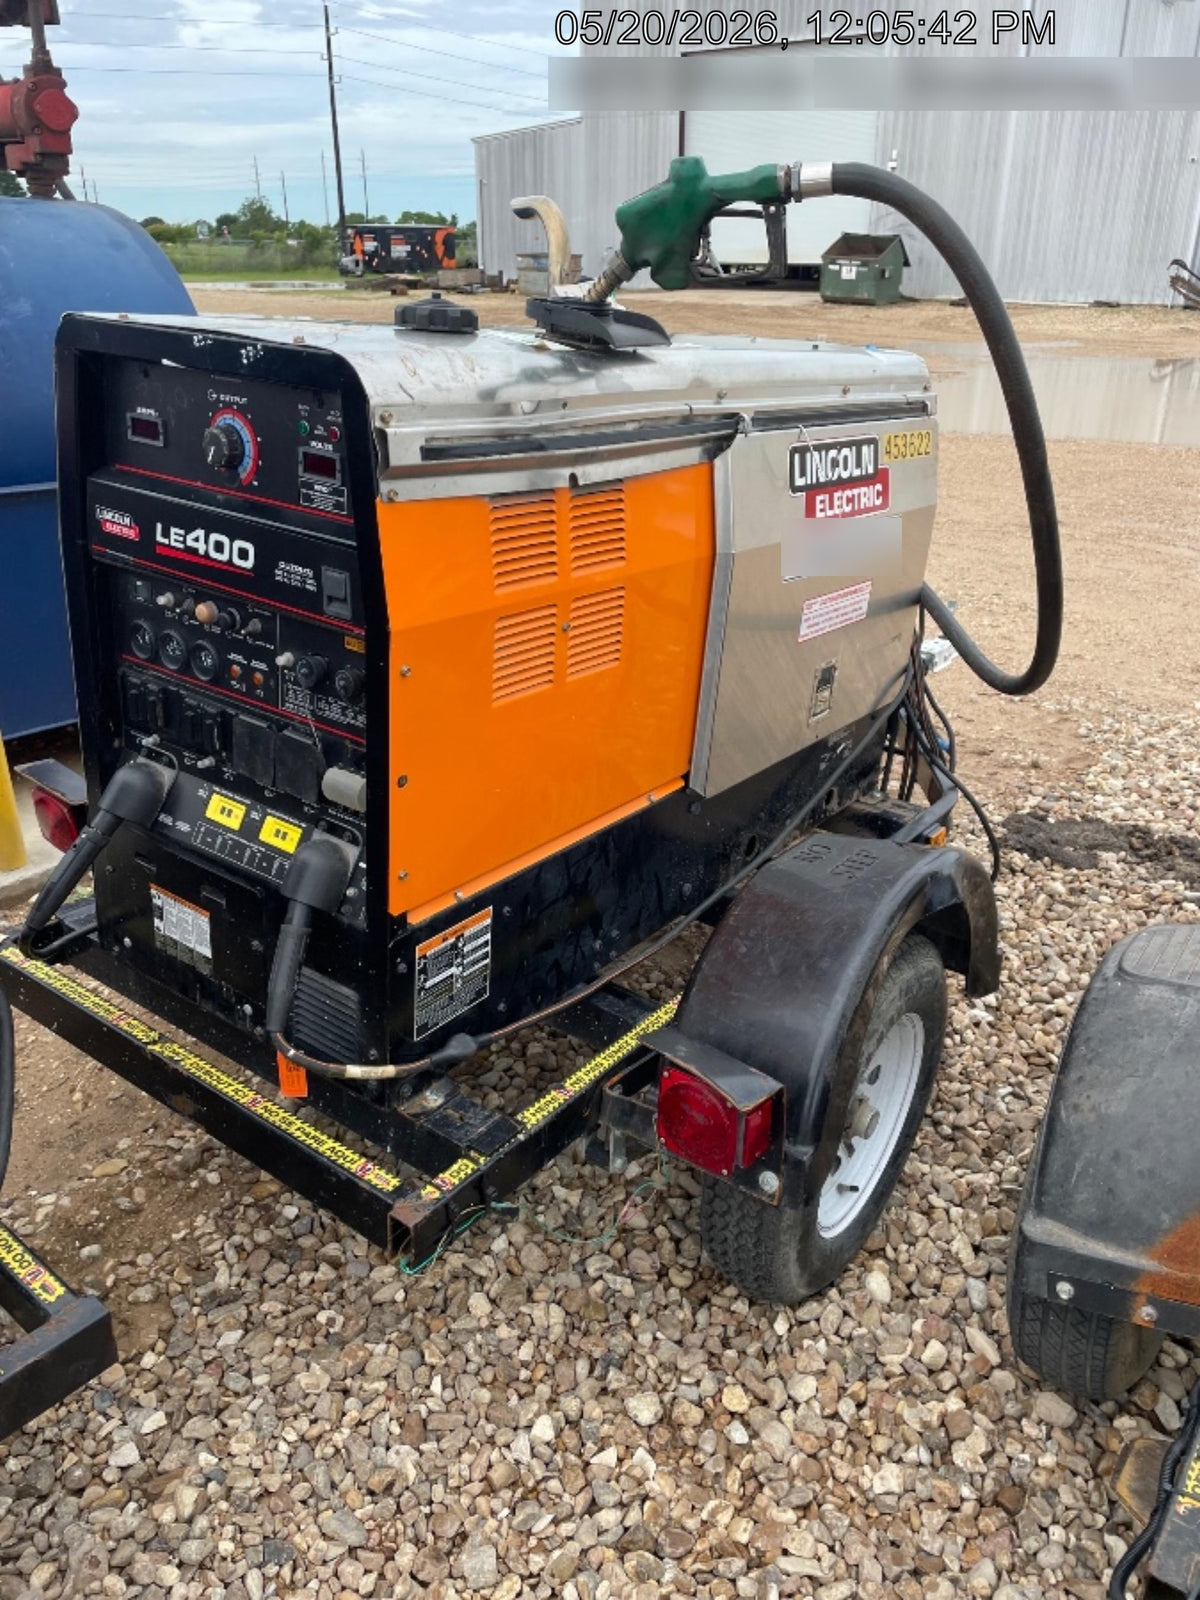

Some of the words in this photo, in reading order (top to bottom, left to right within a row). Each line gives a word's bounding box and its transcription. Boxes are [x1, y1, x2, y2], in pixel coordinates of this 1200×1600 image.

[794, 443, 875, 487] LINCOLN
[884, 431, 931, 460] 453622
[815, 483, 883, 518] ELECTRIC
[156, 521, 255, 570] LE400
[261, 1104, 280, 1118] NO
[294, 1125, 326, 1148] PARE
